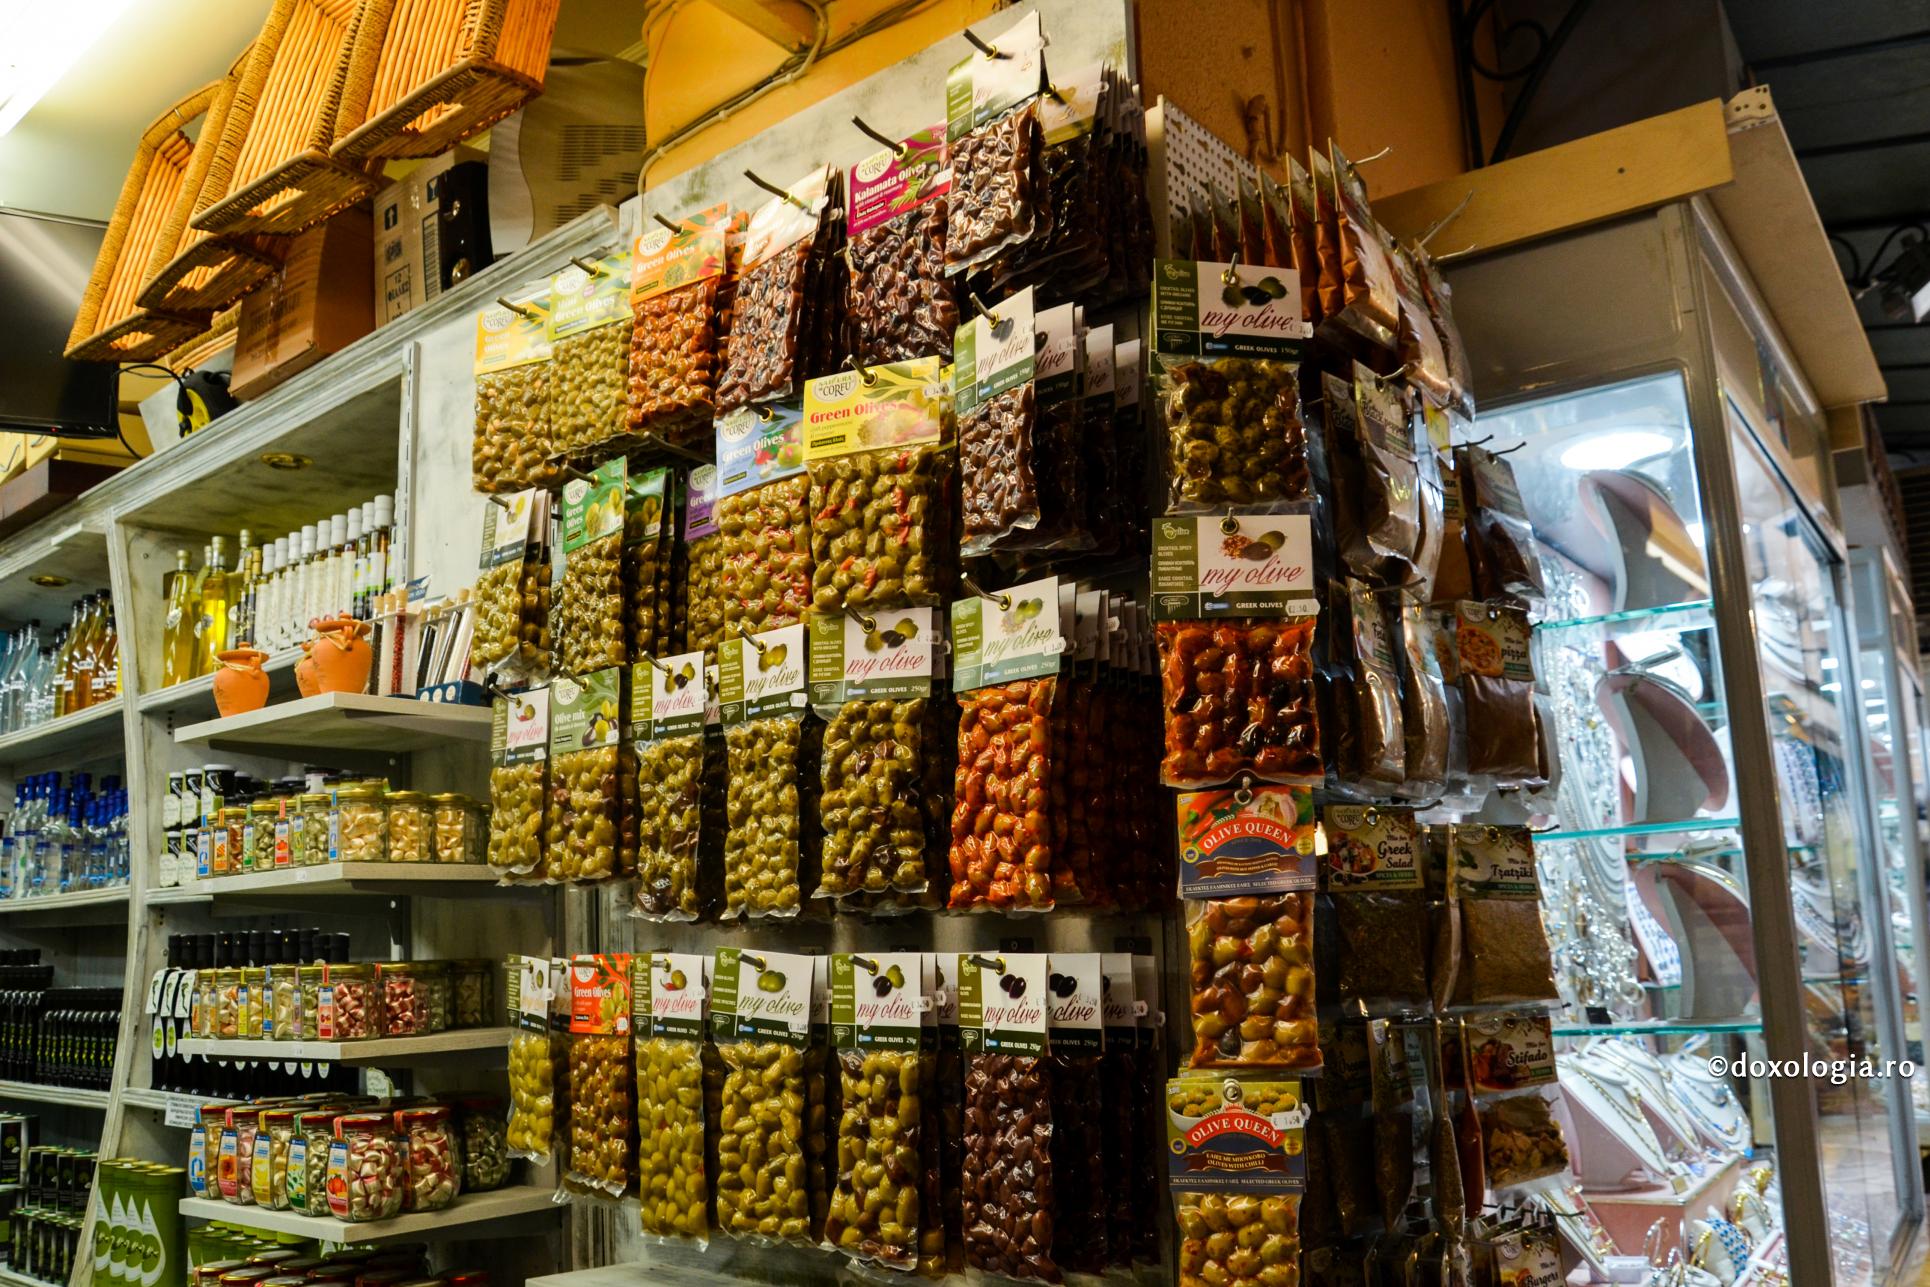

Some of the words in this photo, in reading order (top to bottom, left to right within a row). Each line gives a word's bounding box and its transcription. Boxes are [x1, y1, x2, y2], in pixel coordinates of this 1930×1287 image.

[854, 177, 898, 203] Kalamata
[898, 161, 927, 182] Olives
[585, 295, 617, 312] Olives
[1201, 310, 1241, 338] my
[1241, 304, 1294, 331] olive
[1234, 344, 1254, 352] GREEK
[822, 381, 852, 397] CORFU
[810, 406, 852, 424] Green
[854, 400, 897, 416] Olives
[723, 444, 752, 464] Green
[754, 434, 785, 451] Olives
[566, 504, 584, 517] Green
[566, 516, 584, 529] Olives
[1201, 565, 1243, 597] my
[1245, 554, 1304, 585] olive
[846, 656, 878, 684] my
[879, 645, 926, 672] olive
[1501, 645, 1528, 663] pizza
[745, 676, 768, 704] my
[768, 662, 800, 688] olive
[1203, 823, 1242, 849] OLIVE
[1245, 822, 1292, 843] QUEEN
[1377, 839, 1413, 860] Greek
[1385, 854, 1413, 869] Salad
[1490, 864, 1534, 880] Tzatziki
[574, 987, 593, 998] Green
[653, 996, 672, 1021] my
[673, 991, 698, 1013] olive
[738, 993, 762, 1022] my
[766, 990, 805, 1016] olive
[856, 1002, 879, 1030] my
[881, 993, 913, 1019] olive
[983, 1004, 1005, 1034] my
[1006, 996, 1042, 1024] olive
[1053, 994, 1096, 1022] olive
[773, 1030, 788, 1038] OLIVES
[888, 1036, 904, 1044] OLIVES
[1000, 1040, 1013, 1048] GREEK
[1014, 1041, 1028, 1049] OLIVES
[1506, 1050, 1548, 1068] Stifado
[1191, 1118, 1231, 1142] OLIVE
[1234, 1118, 1280, 1143] QUEEN
[1207, 1160, 1228, 1169] OLIVES
